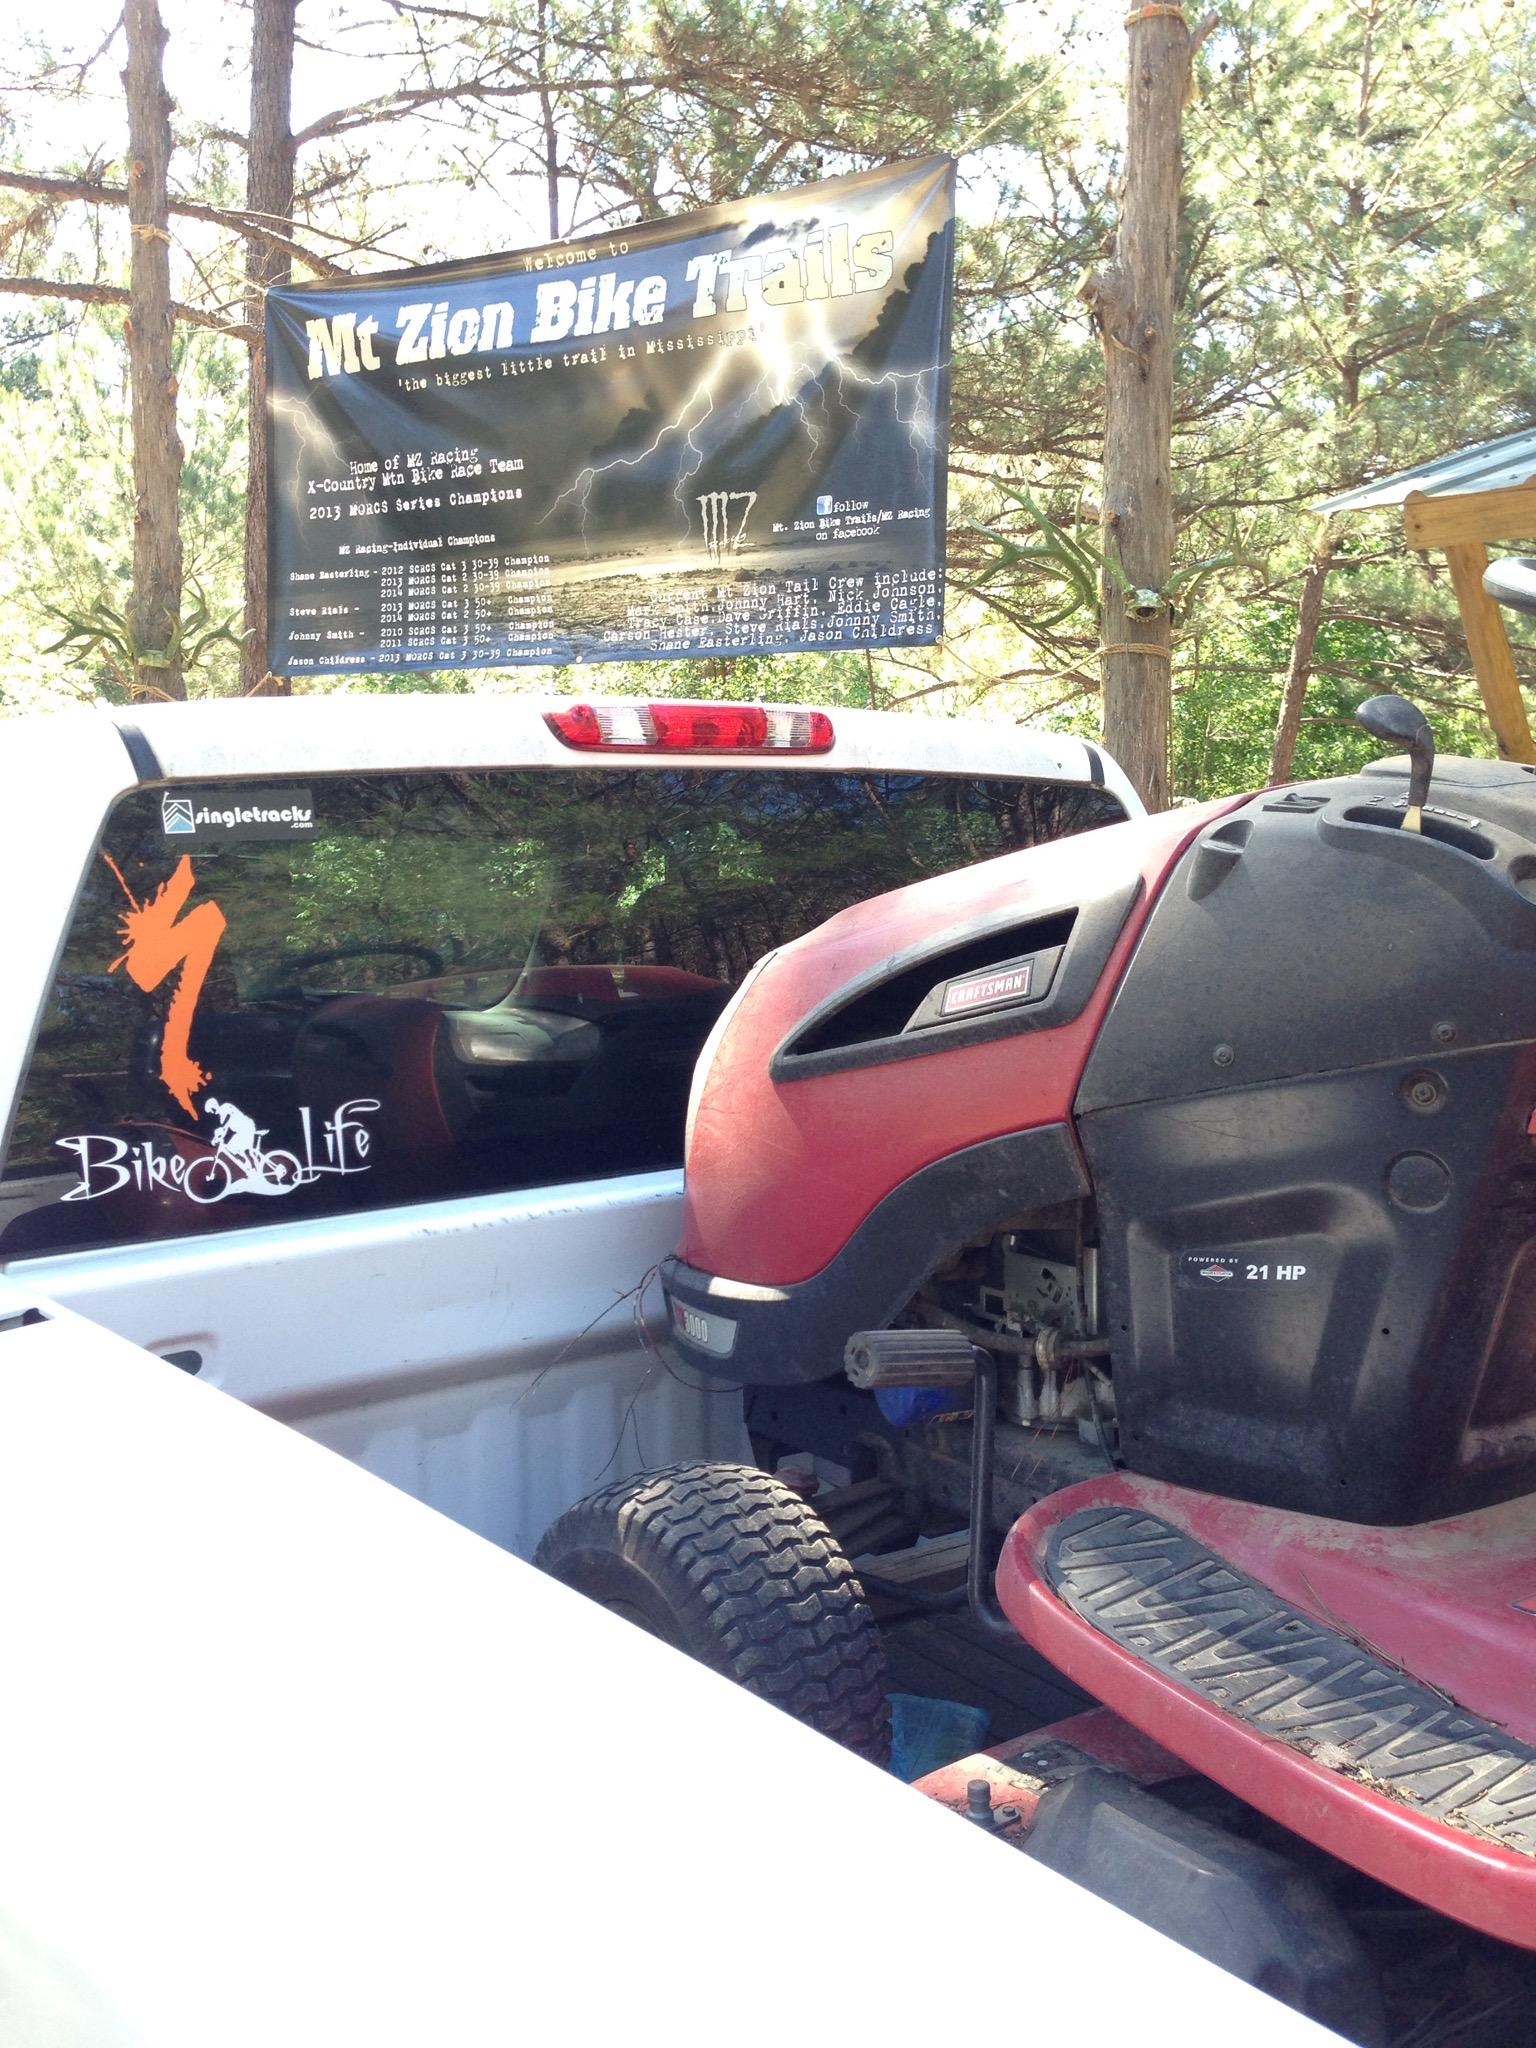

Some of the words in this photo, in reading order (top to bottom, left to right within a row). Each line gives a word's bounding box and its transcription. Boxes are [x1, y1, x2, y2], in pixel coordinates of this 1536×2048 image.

[524, 248, 597, 272] Welcome
[610, 242, 629, 257] to
[305, 312, 381, 380] Mt
[395, 301, 515, 366] Zion
[531, 271, 668, 344] Bike
[685, 223, 894, 318] Trails
[436, 367, 492, 392] biggest
[501, 356, 552, 376] little
[563, 346, 607, 366] trail
[619, 345, 635, 361] in
[350, 460, 378, 475] Home
[384, 454, 400, 470] of
[407, 452, 423, 468] MZ
[430, 447, 479, 465] Racing
[307, 474, 377, 494] X-Country
[382, 471, 405, 487] Mtn
[411, 466, 443, 485] Bike
[451, 463, 482, 479] Race
[489, 457, 524, 474] Team
[309, 505, 341, 521] 2013
[349, 502, 388, 517] MORCS
[396, 497, 441, 512] Series
[449, 487, 523, 506] Champions
[833, 500, 869, 512] follow
[772, 522, 788, 532] Mt.
[794, 520, 815, 531] Zion
[819, 517, 841, 529] Bike
[897, 507, 931, 520] Racing
[815, 532, 828, 541] on
[833, 524, 880, 539] facebook
[338, 544, 351, 555] MZ
[447, 533, 496, 547] Champions
[290, 572, 315, 581] Shane
[381, 566, 404, 575] 2012
[440, 562, 456, 571] Cat
[461, 561, 466, 571] 3
[472, 558, 499, 570] 30-39
[504, 554, 550, 566] Champion
[381, 578, 403, 588] 2013
[441, 574, 457, 583] Cat
[462, 572, 467, 581] 2
[472, 570, 499, 582] 30-39
[505, 567, 550, 578] Champion
[381, 588, 403, 598] 2014
[441, 586, 458, 594] Cat
[463, 584, 468, 593] 2
[473, 582, 500, 593] 30-39
[505, 579, 551, 590] Champion
[717, 586, 734, 598] Mt
[743, 583, 776, 597] Zion
[785, 578, 819, 593] Tail
[828, 576, 864, 590] Crew
[874, 568, 942, 586] include:
[289, 607, 317, 616] Steve
[381, 603, 403, 612] 2013
[441, 600, 458, 608] Cat
[464, 599, 469, 609] 3
[475, 597, 491, 609] 50+
[507, 594, 552, 604] Champion
[828, 588, 864, 602] Nick
[381, 613, 402, 623] 2014
[441, 611, 458, 620] Cat
[463, 610, 469, 619] 2
[475, 609, 491, 620] 50+
[508, 605, 553, 616] Champion
[834, 600, 881, 614] Eddie
[326, 630, 354, 640] Smith
[381, 627, 403, 637] 2010
[441, 625, 458, 634] Cat
[463, 624, 469, 634] 3
[475, 623, 491, 634] 50+
[508, 620, 554, 631] Champion
[380, 639, 402, 648] 2011
[440, 636, 457, 645] Cat
[463, 636, 468, 646] 3
[474, 635, 491, 645] 50+
[508, 632, 553, 642] Champion
[603, 630, 651, 642] Carson
[725, 622, 766, 635] Steve
[650, 638, 691, 651] Shane
[800, 630, 843, 642] Jason
[852, 623, 933, 640] Childress
[287, 655, 314, 666] Jason
[378, 653, 400, 664] 2013
[439, 652, 455, 660] Cat
[460, 651, 466, 661] 3
[471, 649, 501, 661] 30-39
[506, 647, 552, 658] Champion
[195, 806, 312, 828] singletracks
[290, 821, 313, 829] .com
[951, 974, 1022, 1004] CRAFTSMAN
[55, 1133, 188, 1202] Bike
[293, 1098, 381, 1184] Life
[1188, 1256, 1226, 1264] POWERED
[1246, 1264, 1269, 1280] 21
[1276, 1265, 1307, 1281] HP
